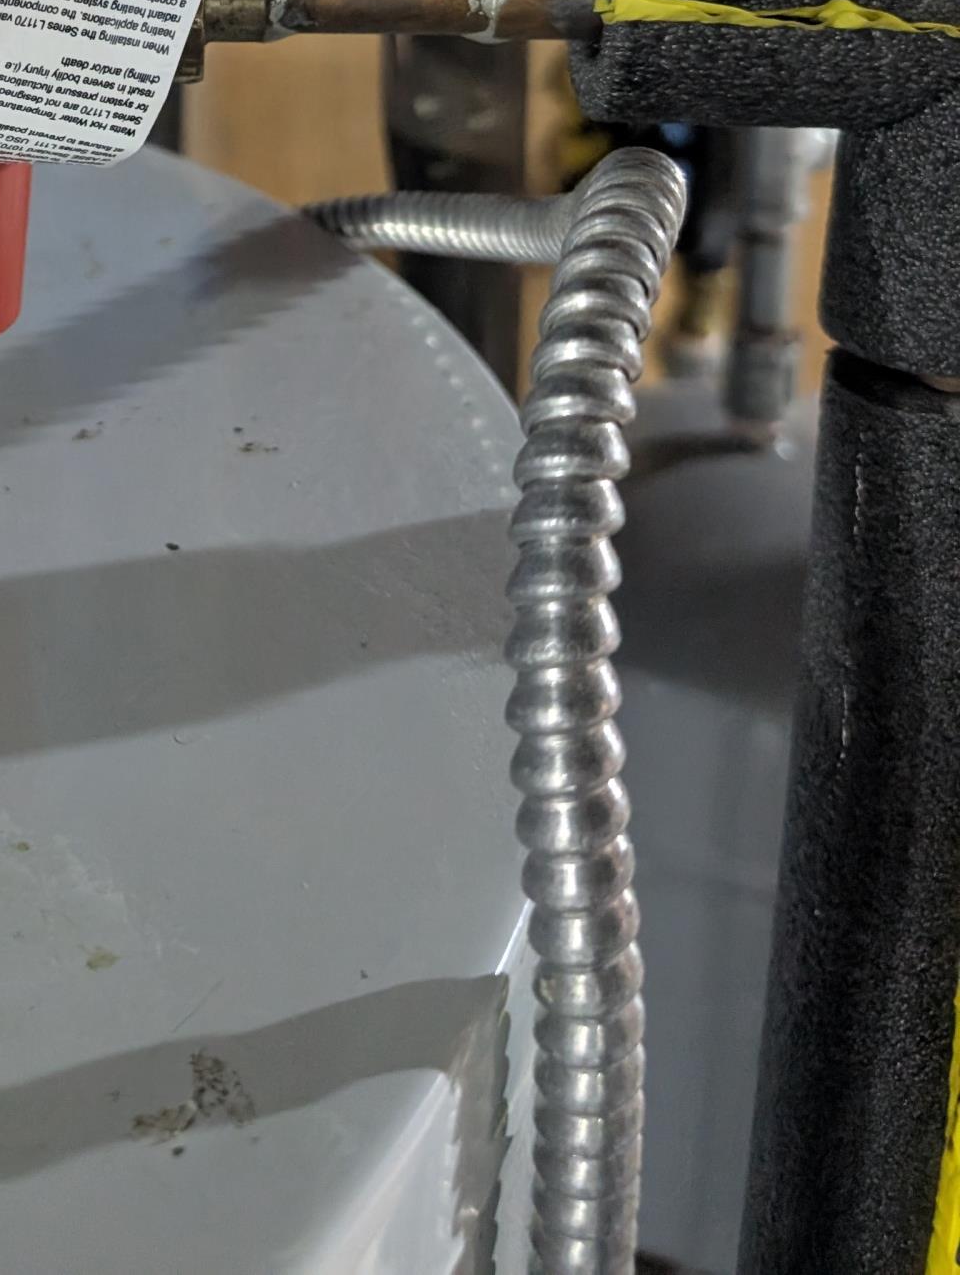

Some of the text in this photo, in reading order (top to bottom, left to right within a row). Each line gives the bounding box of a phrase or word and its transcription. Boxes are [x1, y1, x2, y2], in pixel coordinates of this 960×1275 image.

[111, 0, 147, 19] heating
[180, 0, 187, 8] a
[61, 9, 77, 21] the
[147, 10, 182, 23] radiant
[15, 16, 46, 30] L1170
[47, 22, 80, 38] Series
[81, 29, 97, 41] the
[141, 22, 176, 41] heating
[99, 30, 141, 47] installing
[142, 41, 170, 56] When
[90, 64, 123, 76] and/or
[124, 68, 161, 85] chilling)
[52, 69, 82, 85] bodily
[83, 77, 116, 90] severe
[56, 87, 100, 101] pressure
[118, 84, 127, 95] in
[127, 86, 156, 98] result
[44, 98, 62, 108] not
[63, 102, 80, 111] are
[100, 96, 135, 109] system
[135, 103, 150, 113] for
[80, 106, 111, 119] L1170
[112, 112, 143, 126] Series
[59, 115, 88, 127] Water
[90, 121, 108, 131] Hot
[28, 130, 66, 141] prevent
[110, 125, 136, 138] Watts
[6, 135, 29, 144] USG
[78, 141, 112, 151] fixtures
